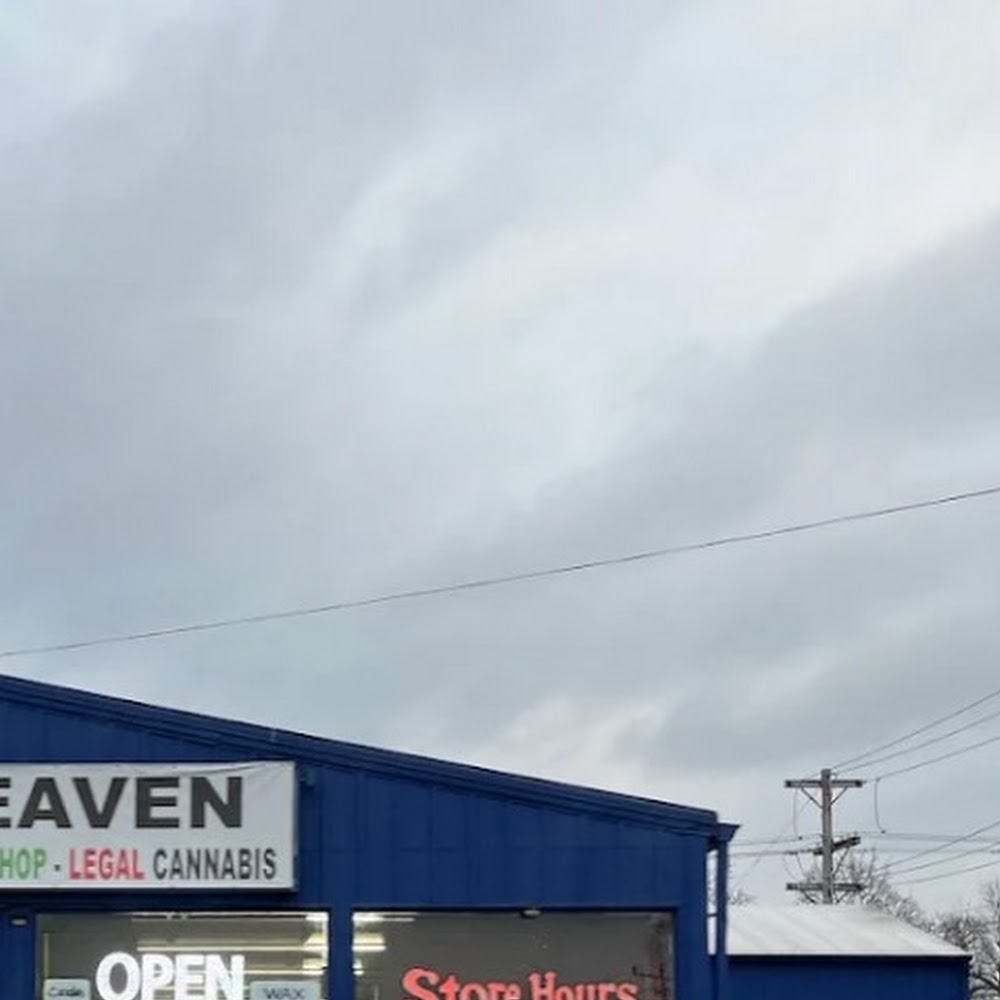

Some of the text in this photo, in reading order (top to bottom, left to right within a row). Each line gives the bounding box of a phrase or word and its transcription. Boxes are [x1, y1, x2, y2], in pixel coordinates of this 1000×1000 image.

[68, 847, 145, 880] LEGAL
[153, 847, 277, 880] CANNABIS
[262, 987, 305, 1000] WAX
